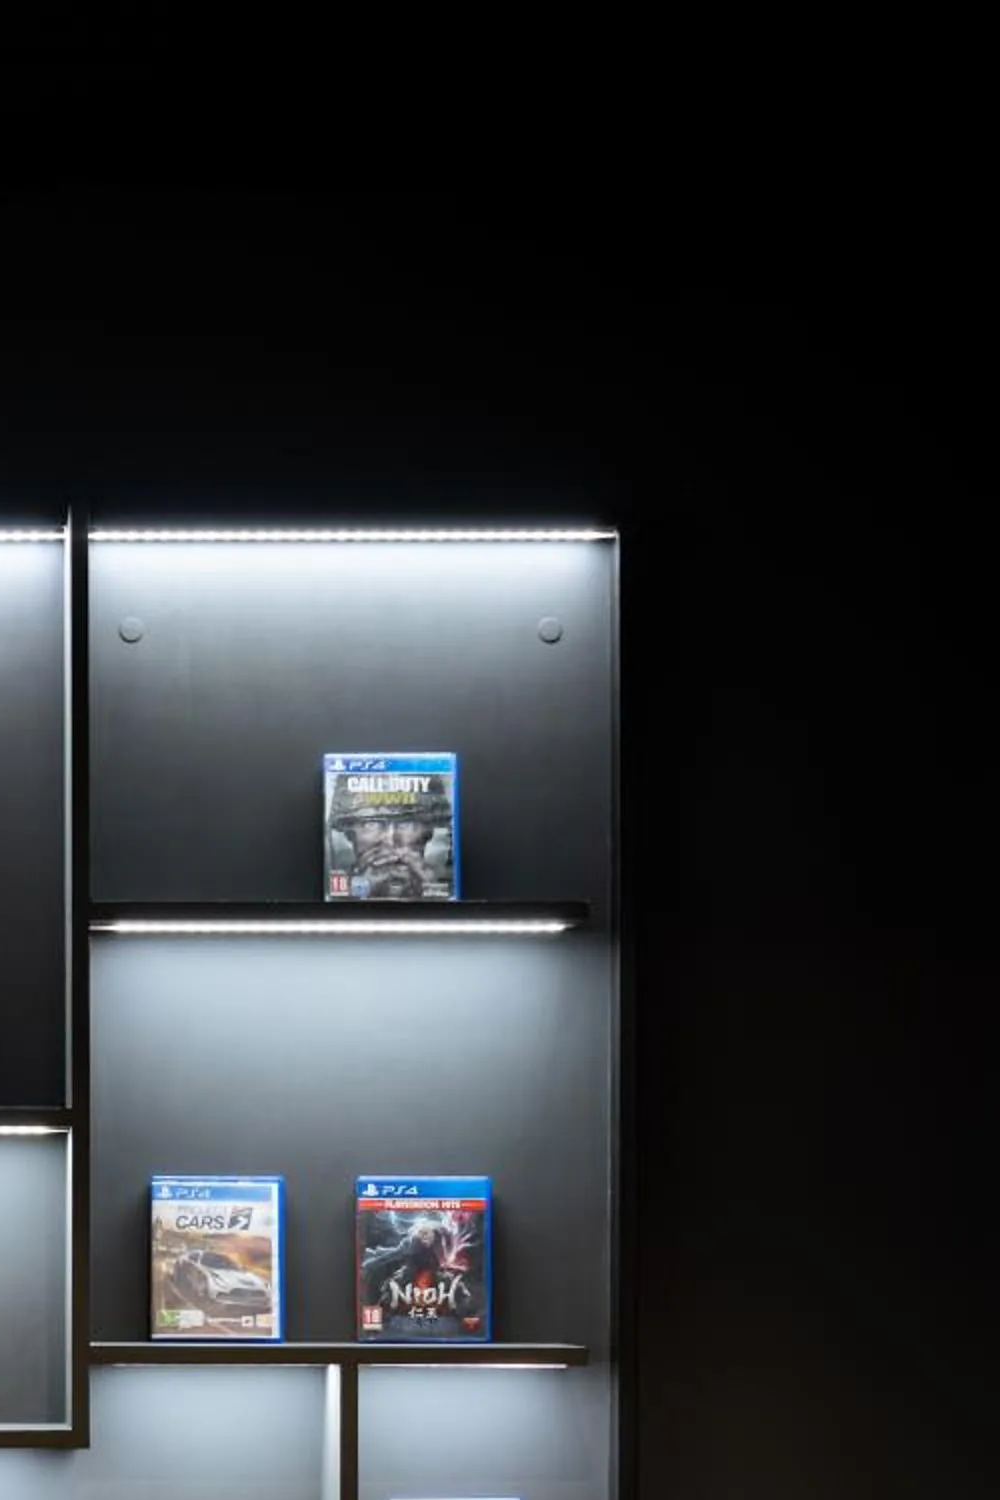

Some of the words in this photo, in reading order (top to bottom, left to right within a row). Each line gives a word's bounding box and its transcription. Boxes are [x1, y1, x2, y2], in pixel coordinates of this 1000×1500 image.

[349, 759, 385, 770] PS4
[347, 776, 384, 792] CALL
[391, 776, 431, 792] DUTY
[382, 1185, 418, 1195] PS4
[175, 1215, 225, 1230] CARS
